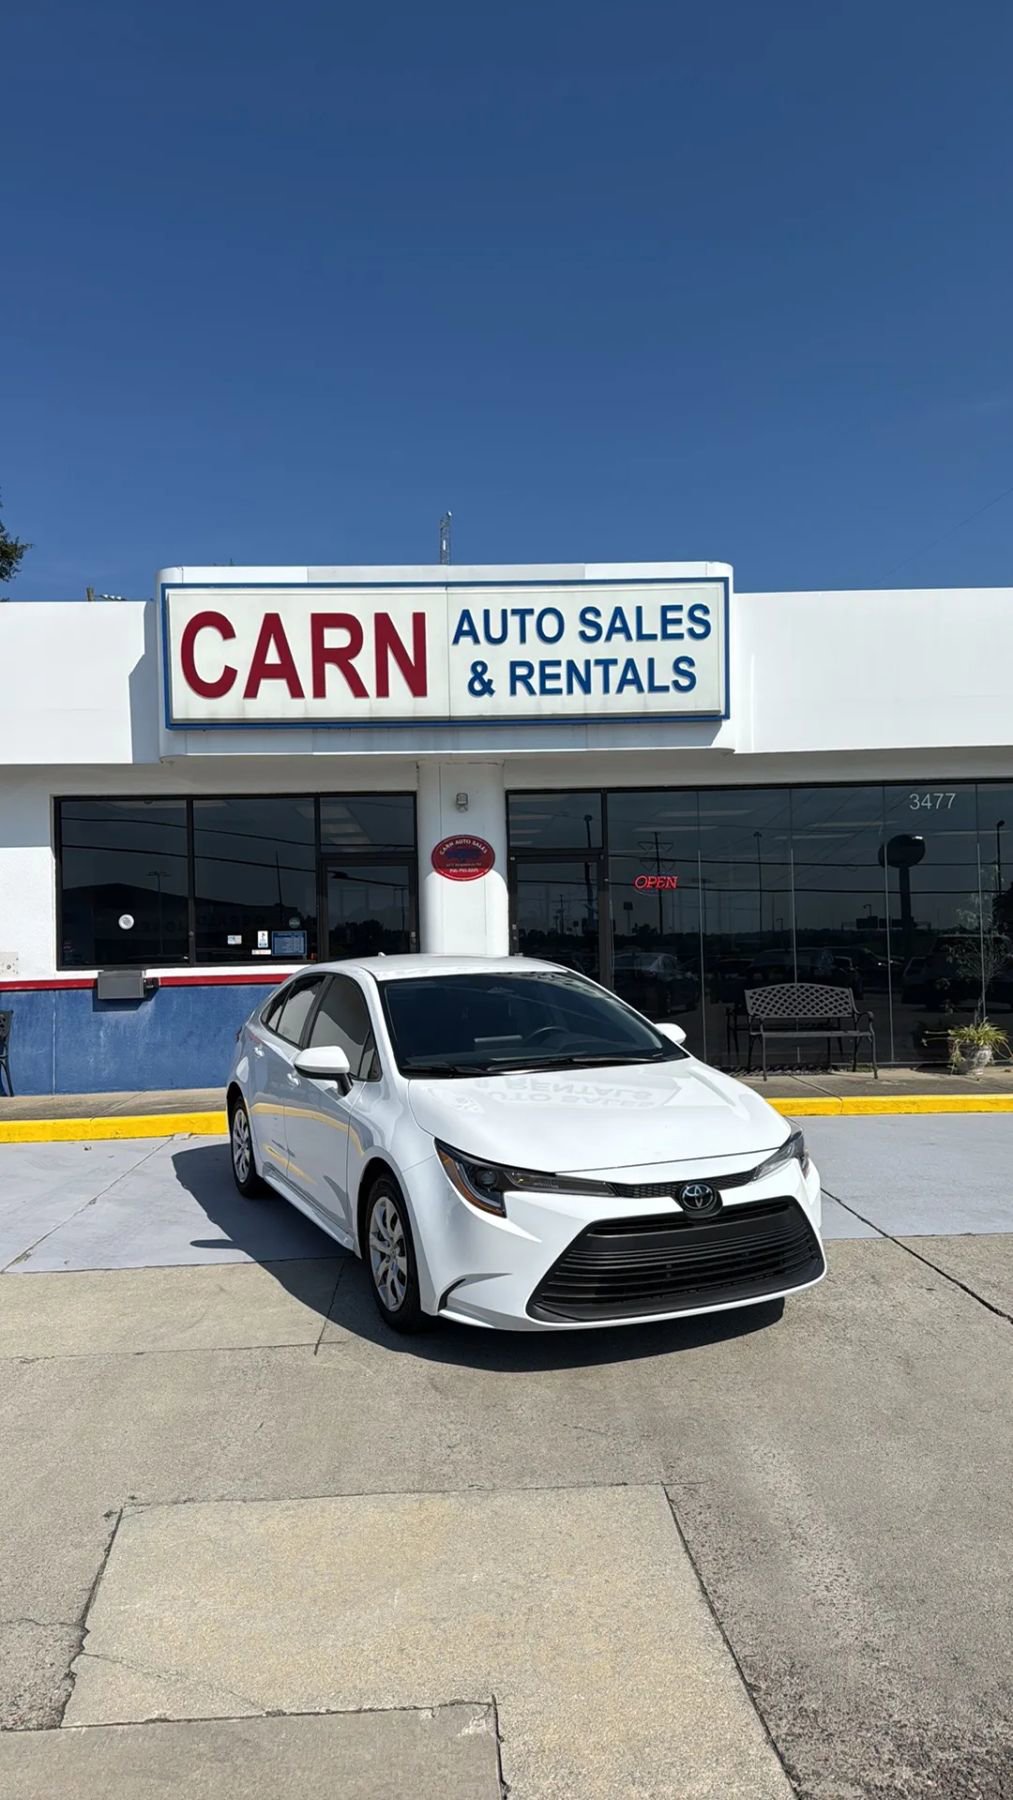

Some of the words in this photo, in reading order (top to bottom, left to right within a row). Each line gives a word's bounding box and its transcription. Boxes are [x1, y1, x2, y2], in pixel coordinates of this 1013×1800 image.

[453, 608, 564, 645] AUTO
[579, 604, 711, 643] SALES
[181, 611, 427, 699] CARN
[468, 661, 495, 697] &
[510, 656, 696, 696] RENTALS
[910, 793, 956, 810] 3477
[472, 840, 488, 854] SALES
[635, 875, 678, 889] OPEN
